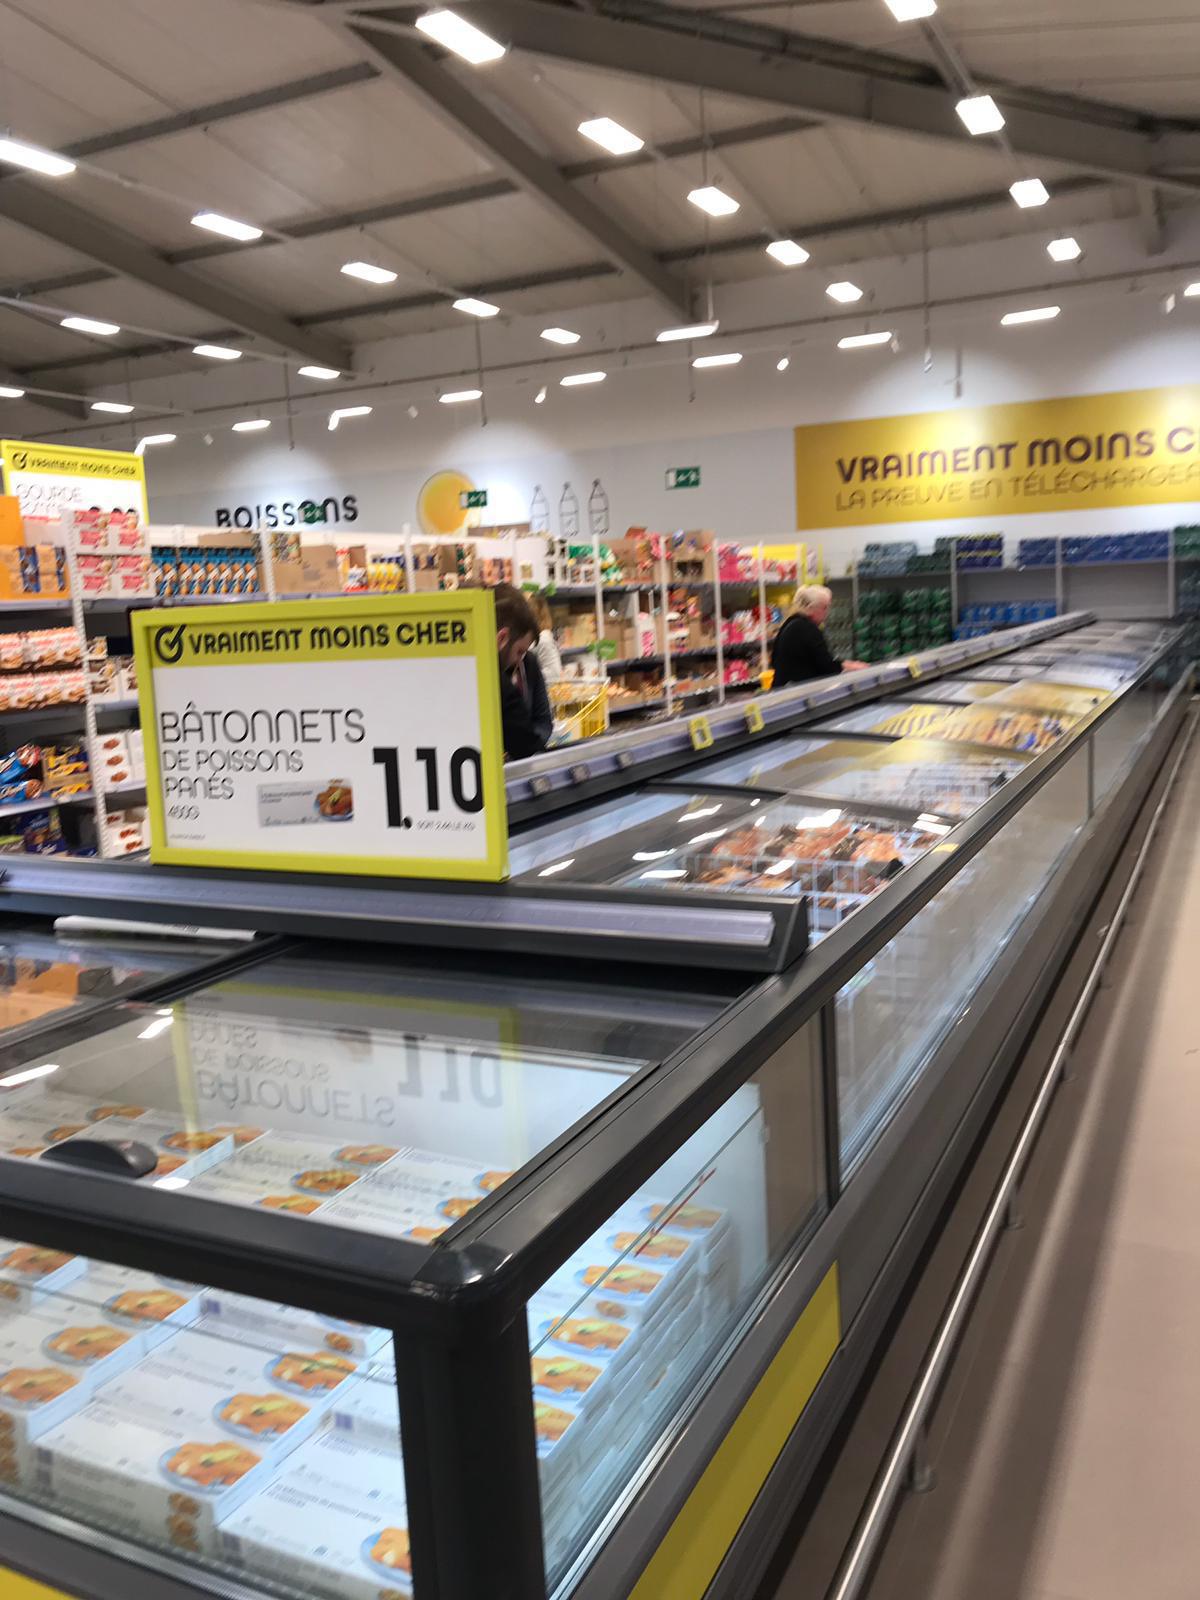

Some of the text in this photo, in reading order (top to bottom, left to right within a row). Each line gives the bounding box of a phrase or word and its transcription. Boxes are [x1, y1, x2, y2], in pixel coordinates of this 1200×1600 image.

[835, 426, 1200, 484] VRAIMENT MOINS C
[835, 489, 866, 512] LA
[871, 478, 964, 508] PREUVE
[969, 478, 1002, 501] EN
[189, 620, 467, 655] VRAIMENT MOINS CHER
[160, 701, 366, 744] BÂTONNETS
[163, 749, 304, 772] DE POISSONS
[164, 772, 234, 800] PANÉS
